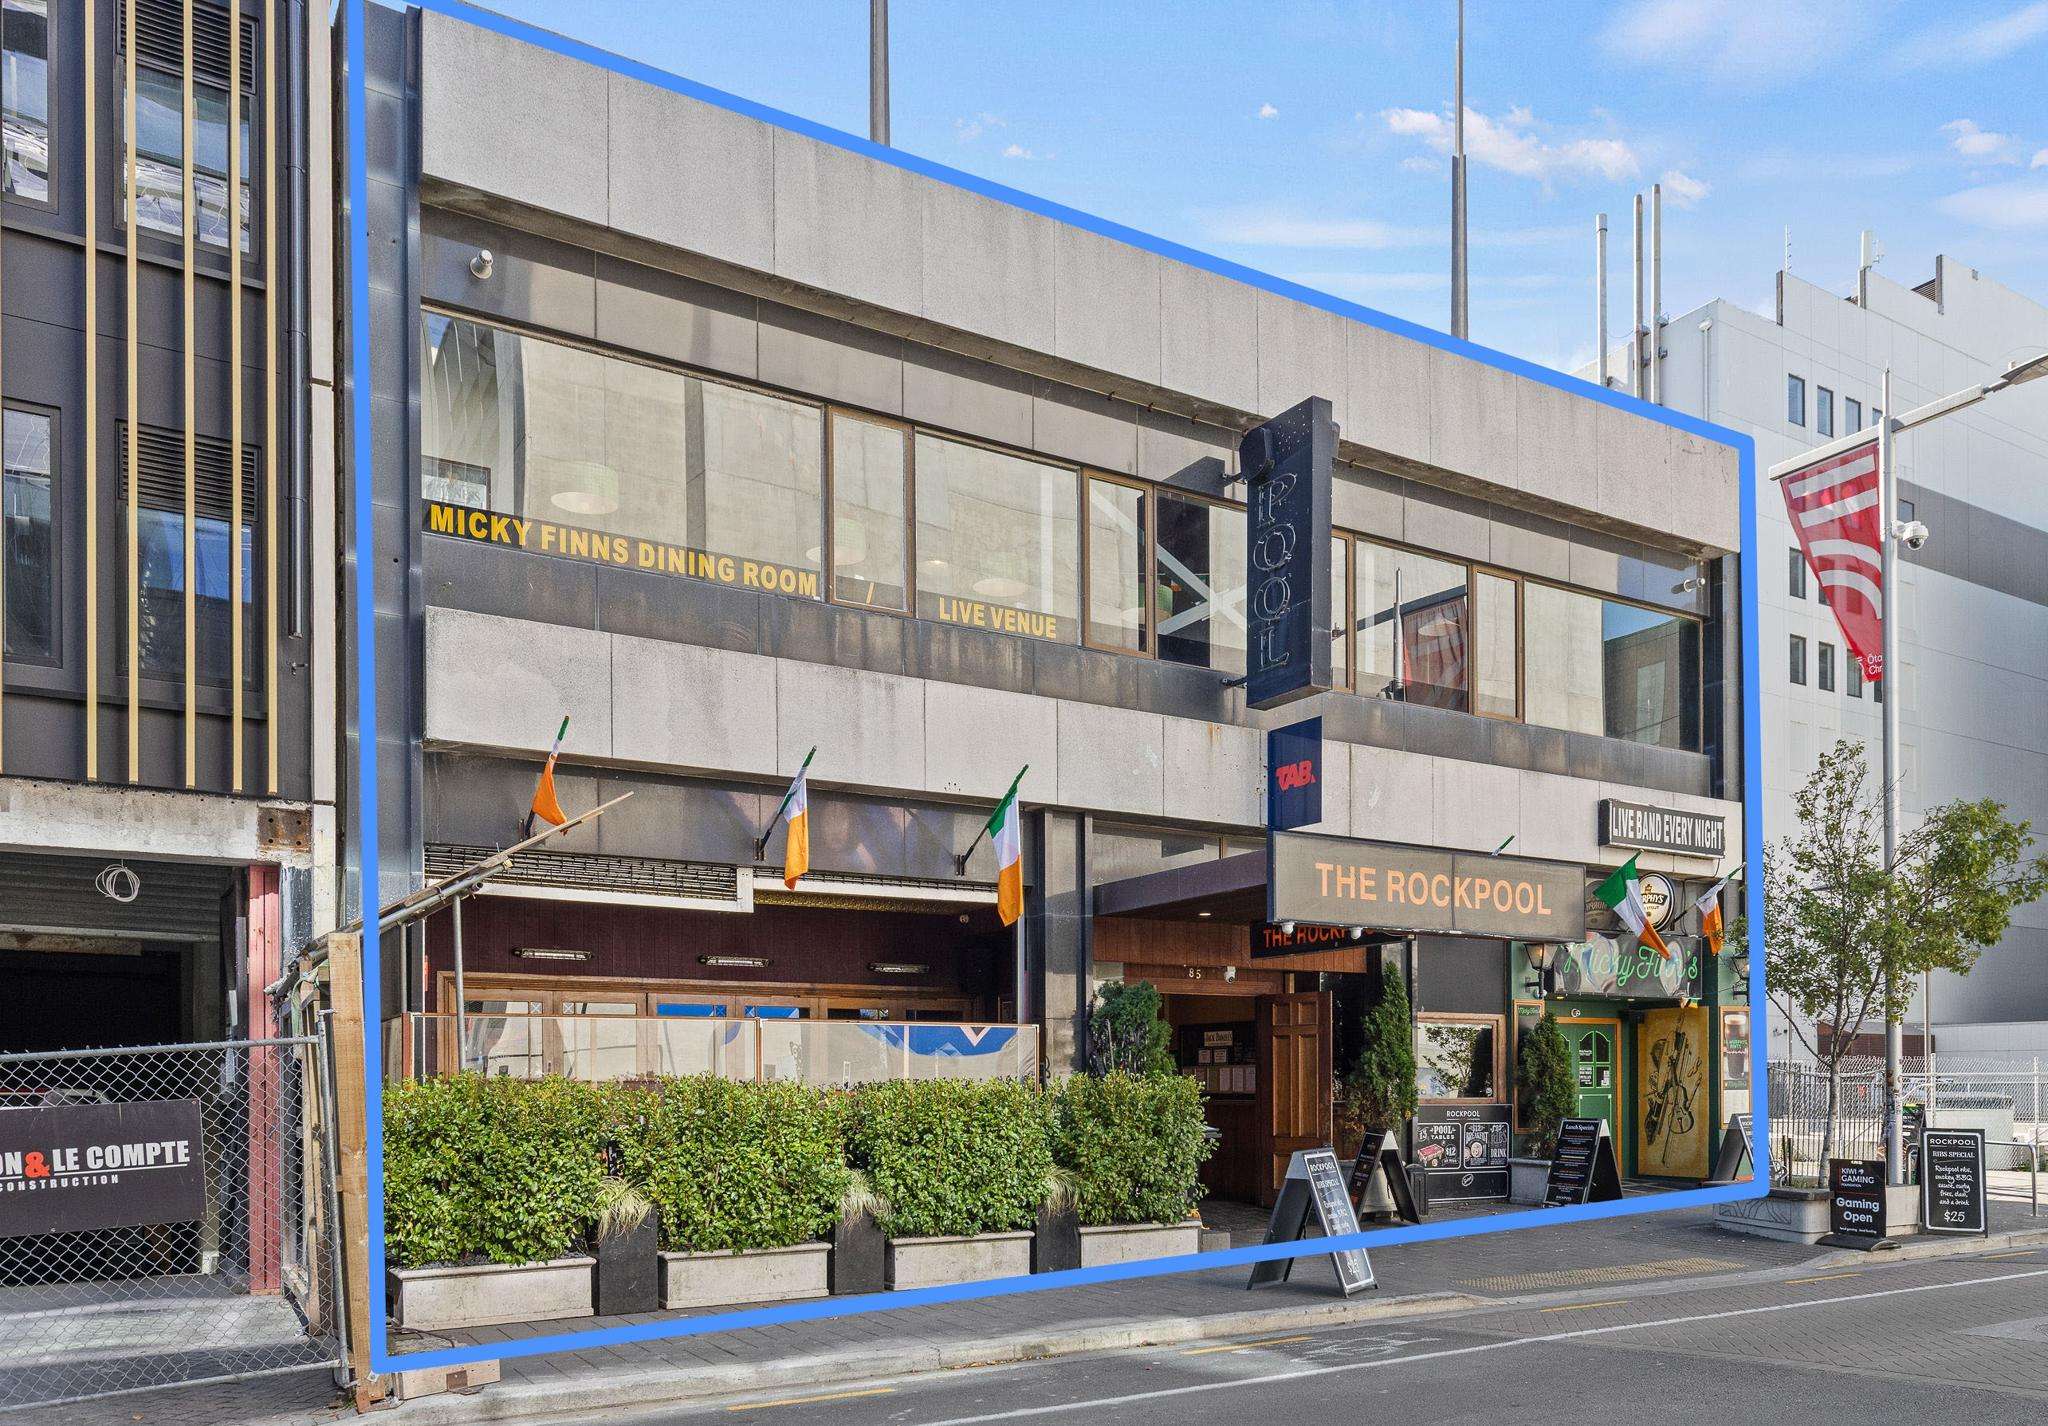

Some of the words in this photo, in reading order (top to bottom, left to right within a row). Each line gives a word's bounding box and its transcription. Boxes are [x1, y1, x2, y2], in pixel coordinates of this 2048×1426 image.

[429, 504, 533, 547] MICKY
[540, 524, 630, 565] FINNS
[637, 542, 736, 583] DINING
[743, 562, 818, 598] ROOM
[939, 597, 986, 627] LIVE
[990, 606, 1057, 640] VENUE
[1252, 472, 1298, 672] POOL
[1612, 805, 1635, 839] LIVE
[1636, 810, 1662, 843] BAND
[1663, 813, 1693, 847] EVERY
[1695, 817, 1723, 850] NIGHT
[1315, 862, 1377, 901] THE
[1387, 870, 1552, 916] ROCKPOOL
[1264, 928, 1292, 949] THE
[1446, 1110, 1481, 1118] ROCKPOOL
[1433, 1125, 1453, 1135] POOL
[1929, 1138, 1976, 1146] ROCKPOOL
[52, 1148, 80, 1172] LE
[86, 1140, 191, 1170] COMPTE
[1932, 1150, 1948, 1158] RIBS
[1841, 1167, 1857, 1175] KIWI
[1841, 1175, 1875, 1184] GAMING
[1836, 1197, 1880, 1213] Gaming
[1843, 1211, 1873, 1223] Open
[1944, 1209, 1965, 1223] $25
